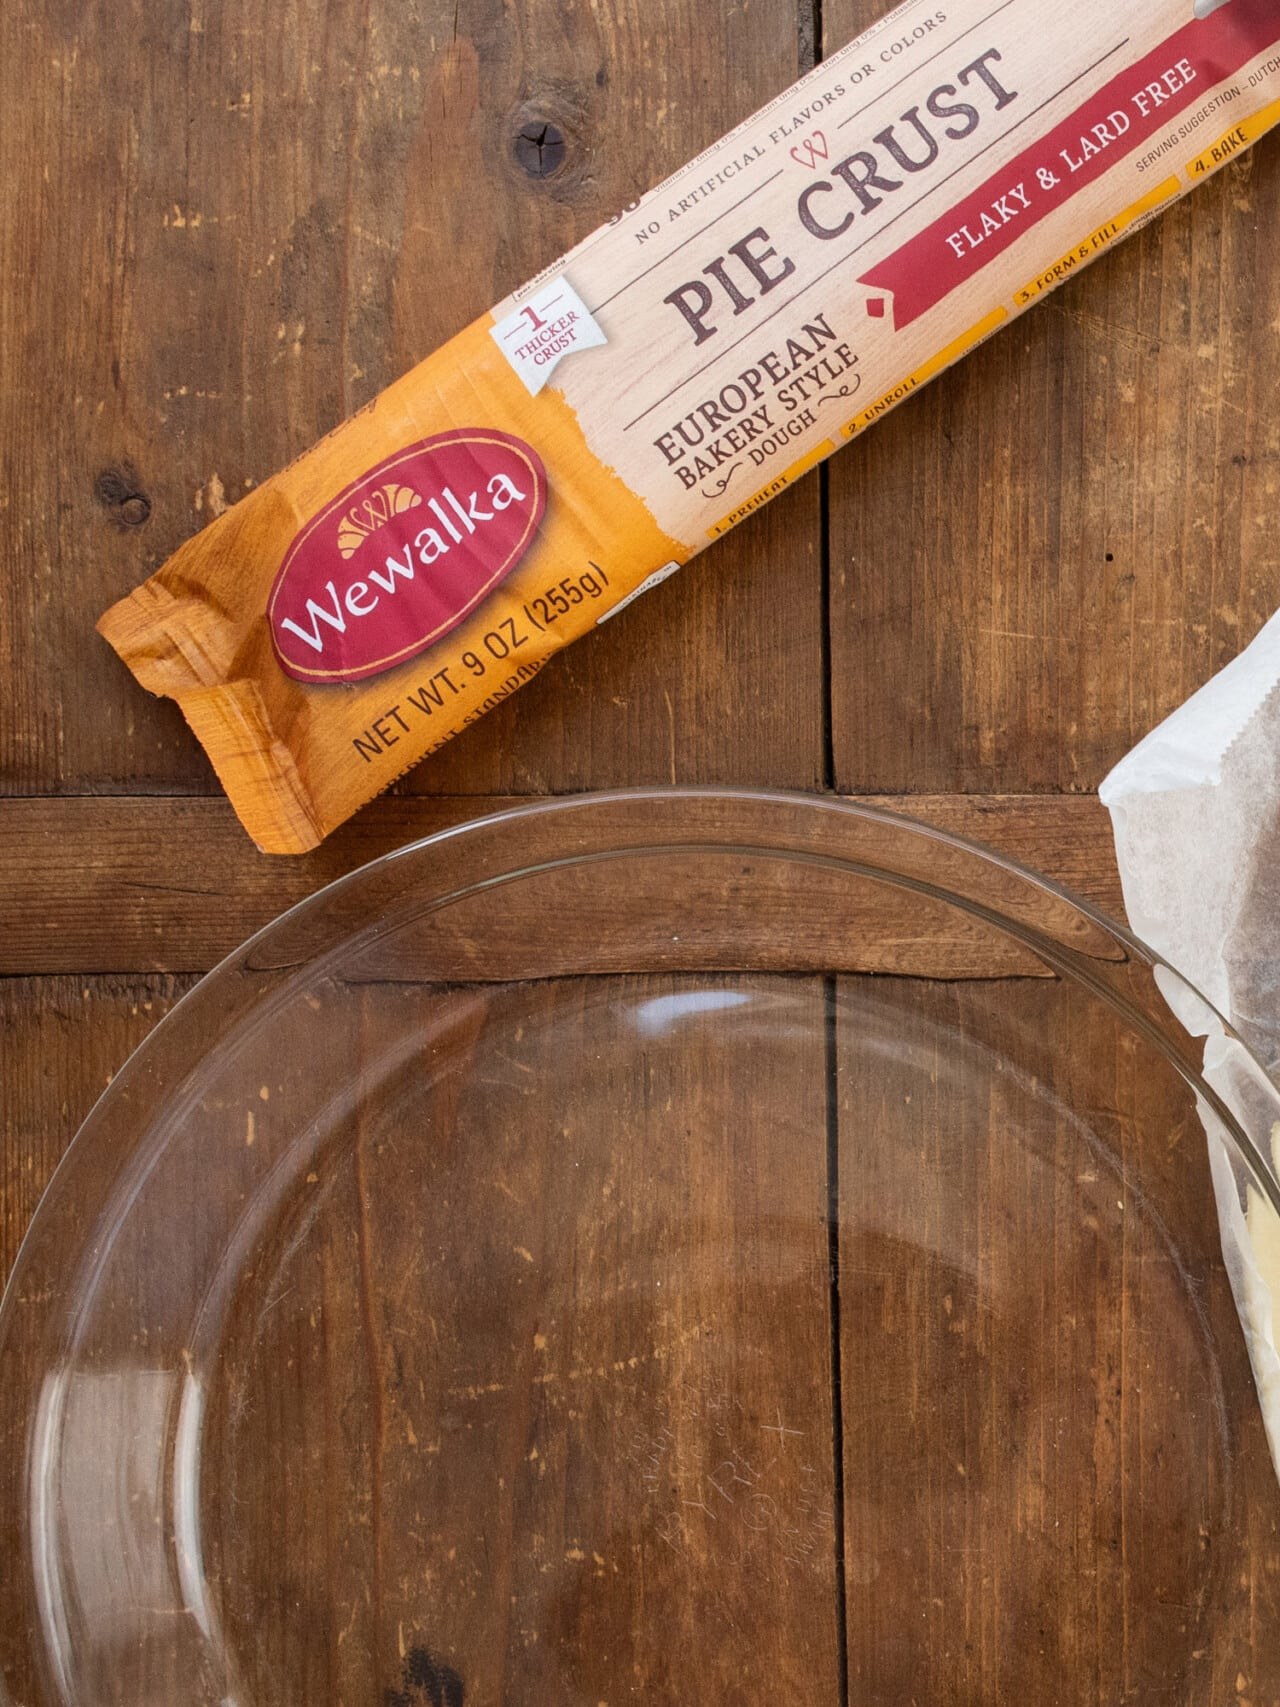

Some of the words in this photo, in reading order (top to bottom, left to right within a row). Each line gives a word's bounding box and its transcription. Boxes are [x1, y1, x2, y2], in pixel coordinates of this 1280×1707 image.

[634, 221, 662, 245] NO
[668, 145, 766, 224] ARTIFICIAL
[768, 83, 847, 144] FLAVORS
[850, 62, 876, 85] OR
[880, 10, 948, 63] COLORS
[945, 183, 1032, 259] FLAKY
[1036, 167, 1061, 191] &
[1060, 109, 1131, 173] LARD
[1131, 57, 1198, 118] FREE
[1135, 132, 1180, 174] SERVING
[1177, 86, 1241, 140] SUGGESTION
[1194, 158, 1211, 175] 4.
[1211, 127, 1249, 163] BAKE
[664, 226, 797, 347] PIE
[797, 47, 1019, 240] CRUST
[1018, 288, 1036, 304] 3.
[1036, 254, 1078, 291] FORM
[1091, 222, 1121, 250] FILL
[514, 311, 580, 360] THICKER
[520, 306, 548, 332] 1
[533, 328, 577, 366] CRUST
[653, 312, 837, 466] EUROPEAN
[674, 404, 776, 490] BAKERY
[777, 342, 859, 412] STYLE
[864, 377, 921, 421] UNROLL
[750, 409, 818, 467] DOUGH
[728, 475, 789, 526] PREHEAT
[280, 473, 527, 654] Wewalka
[352, 709, 411, 764] NET
[407, 667, 467, 716] WT.
[462, 651, 486, 678] 9
[483, 618, 530, 661] OZ
[525, 560, 611, 632] (255g)
